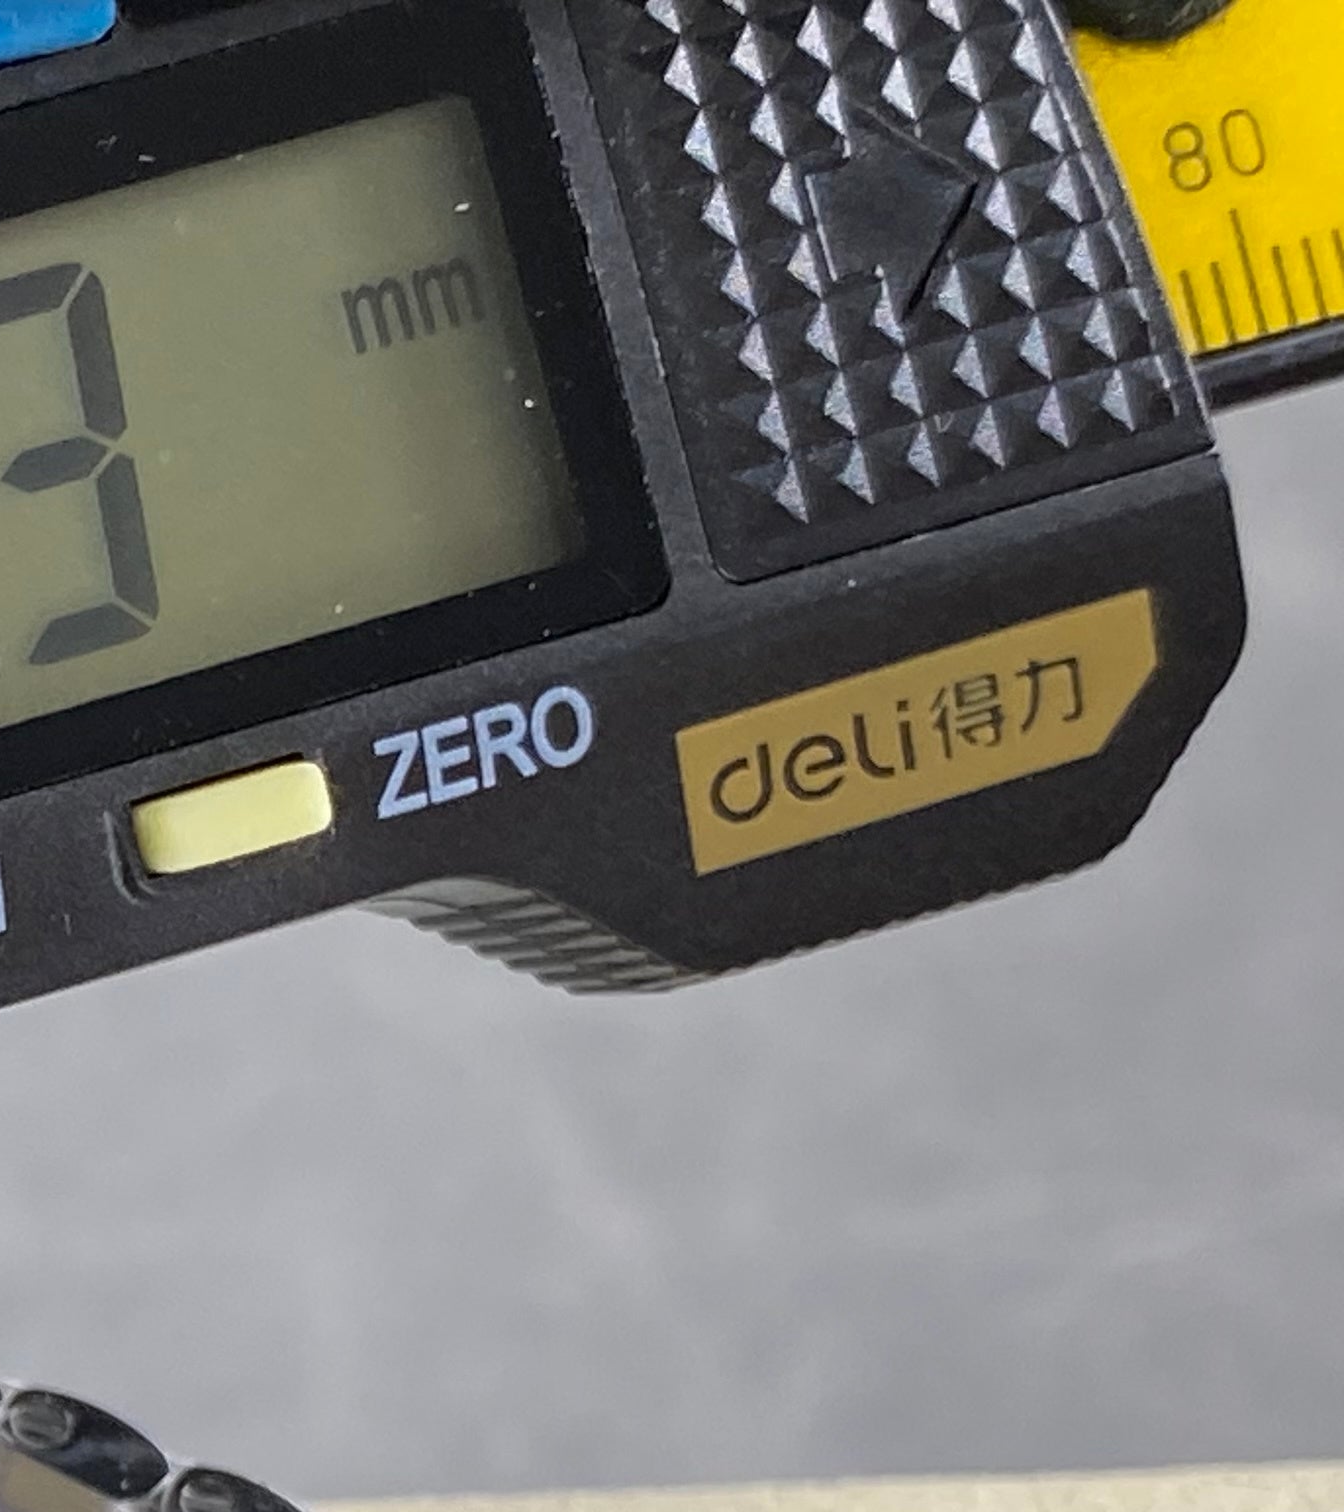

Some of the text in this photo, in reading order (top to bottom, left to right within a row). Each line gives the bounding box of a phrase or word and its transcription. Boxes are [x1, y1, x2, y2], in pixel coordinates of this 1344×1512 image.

[1162, 108, 1266, 192] 80
[339, 256, 486, 354] mm
[372, 684, 595, 820] ZERO
